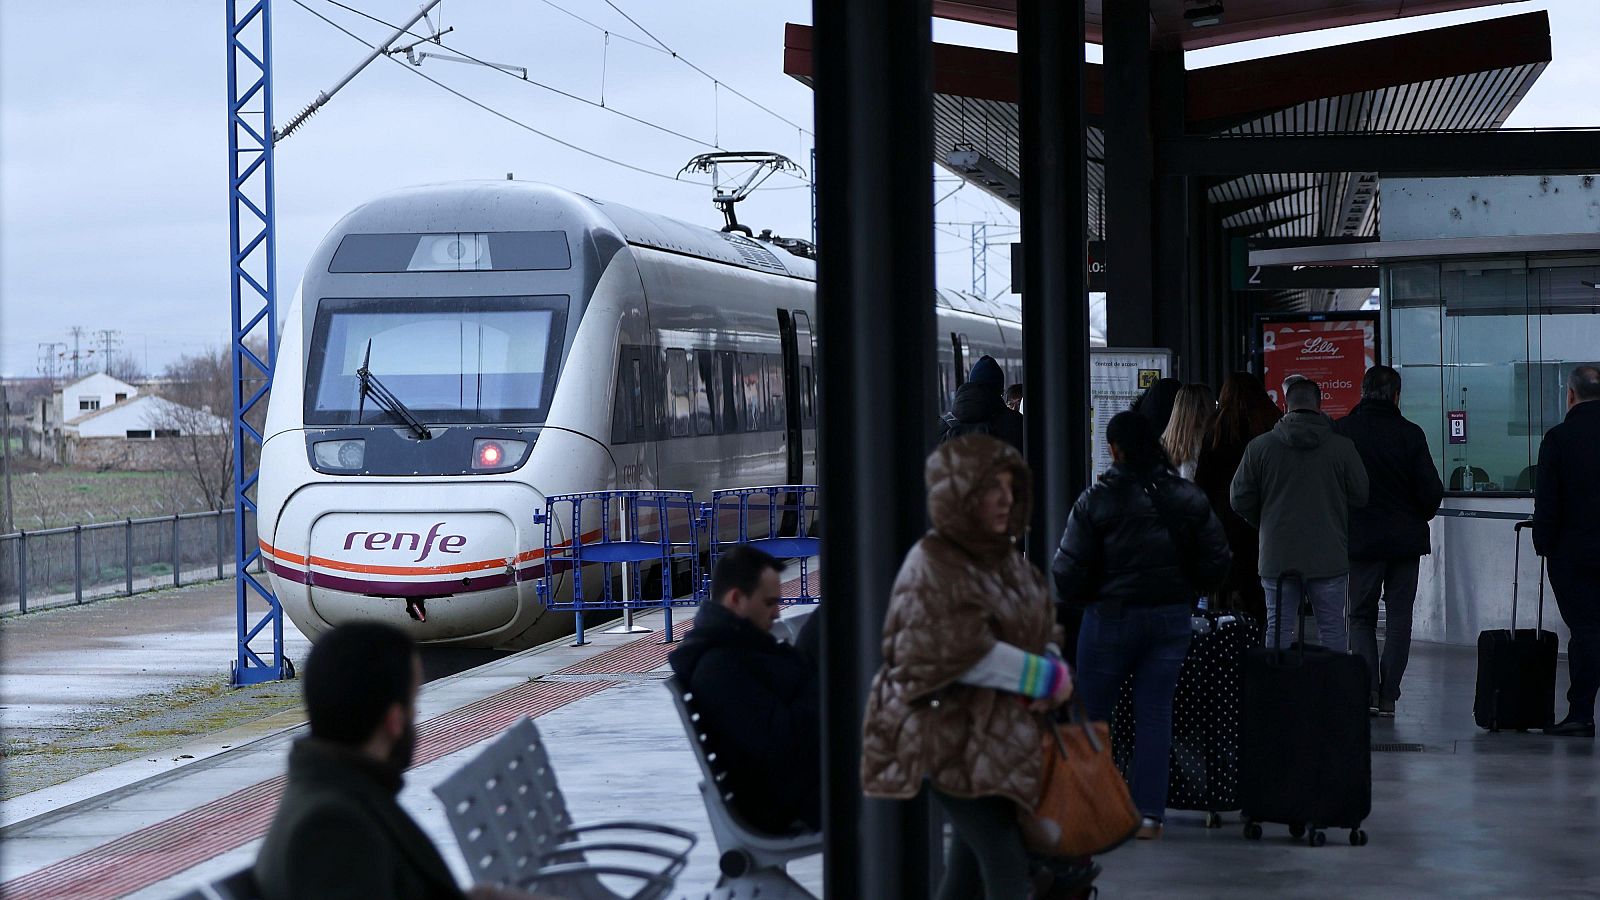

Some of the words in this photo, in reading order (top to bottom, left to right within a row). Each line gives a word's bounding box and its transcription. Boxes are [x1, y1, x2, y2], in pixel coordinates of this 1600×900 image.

[1248, 265, 1261, 284] 2
[1301, 336, 1340, 355] Lilly
[343, 522, 467, 563] renfe
